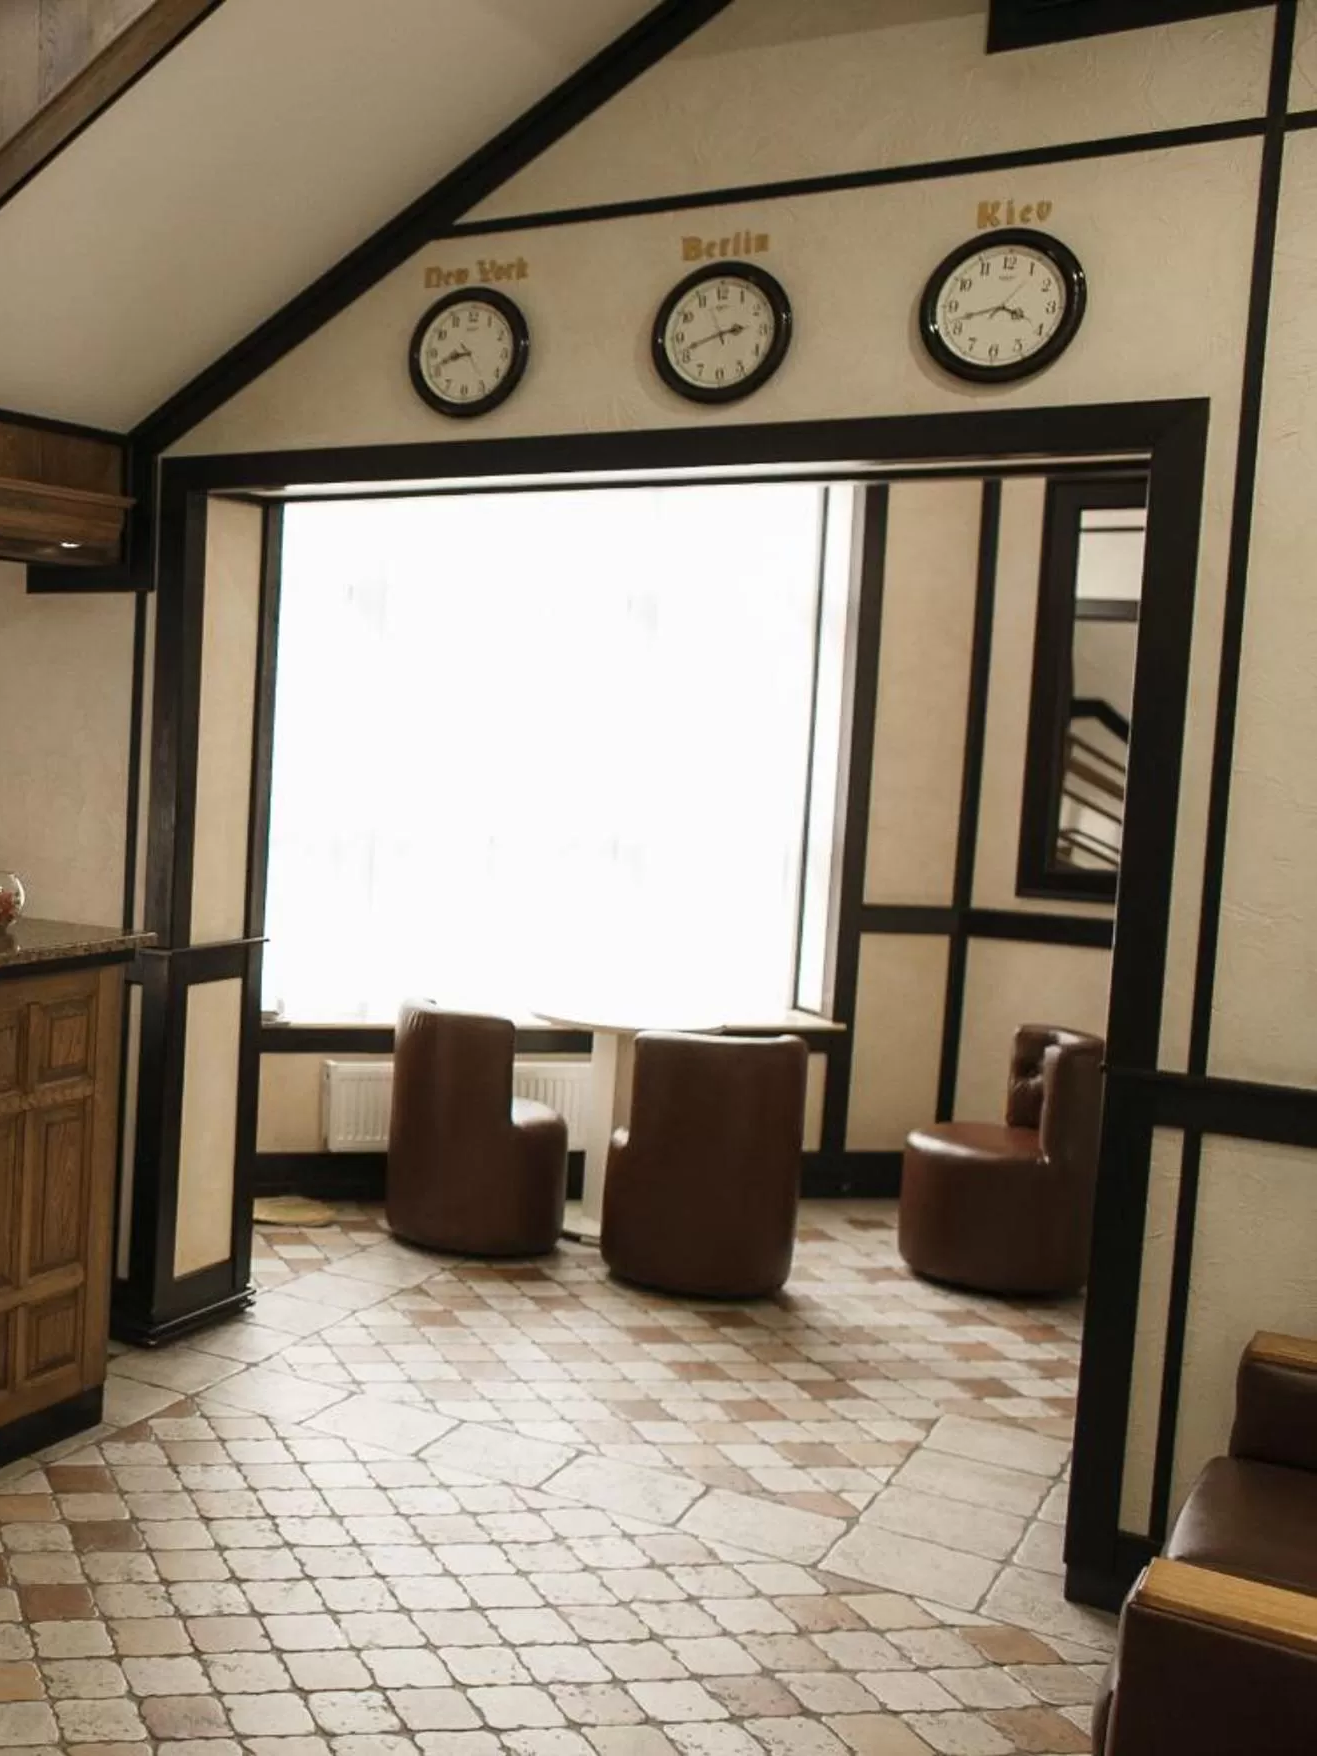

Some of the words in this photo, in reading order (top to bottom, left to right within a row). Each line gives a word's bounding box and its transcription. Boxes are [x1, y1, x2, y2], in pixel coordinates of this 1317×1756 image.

[977, 199, 1052, 229] Kiev
[681, 229, 770, 261] Berlin
[477, 257, 529, 282] York
[1003, 256, 1017, 270] 12
[959, 278, 972, 292] 10
[1041, 278, 1051, 292] 2
[1045, 300, 1057, 314] 3
